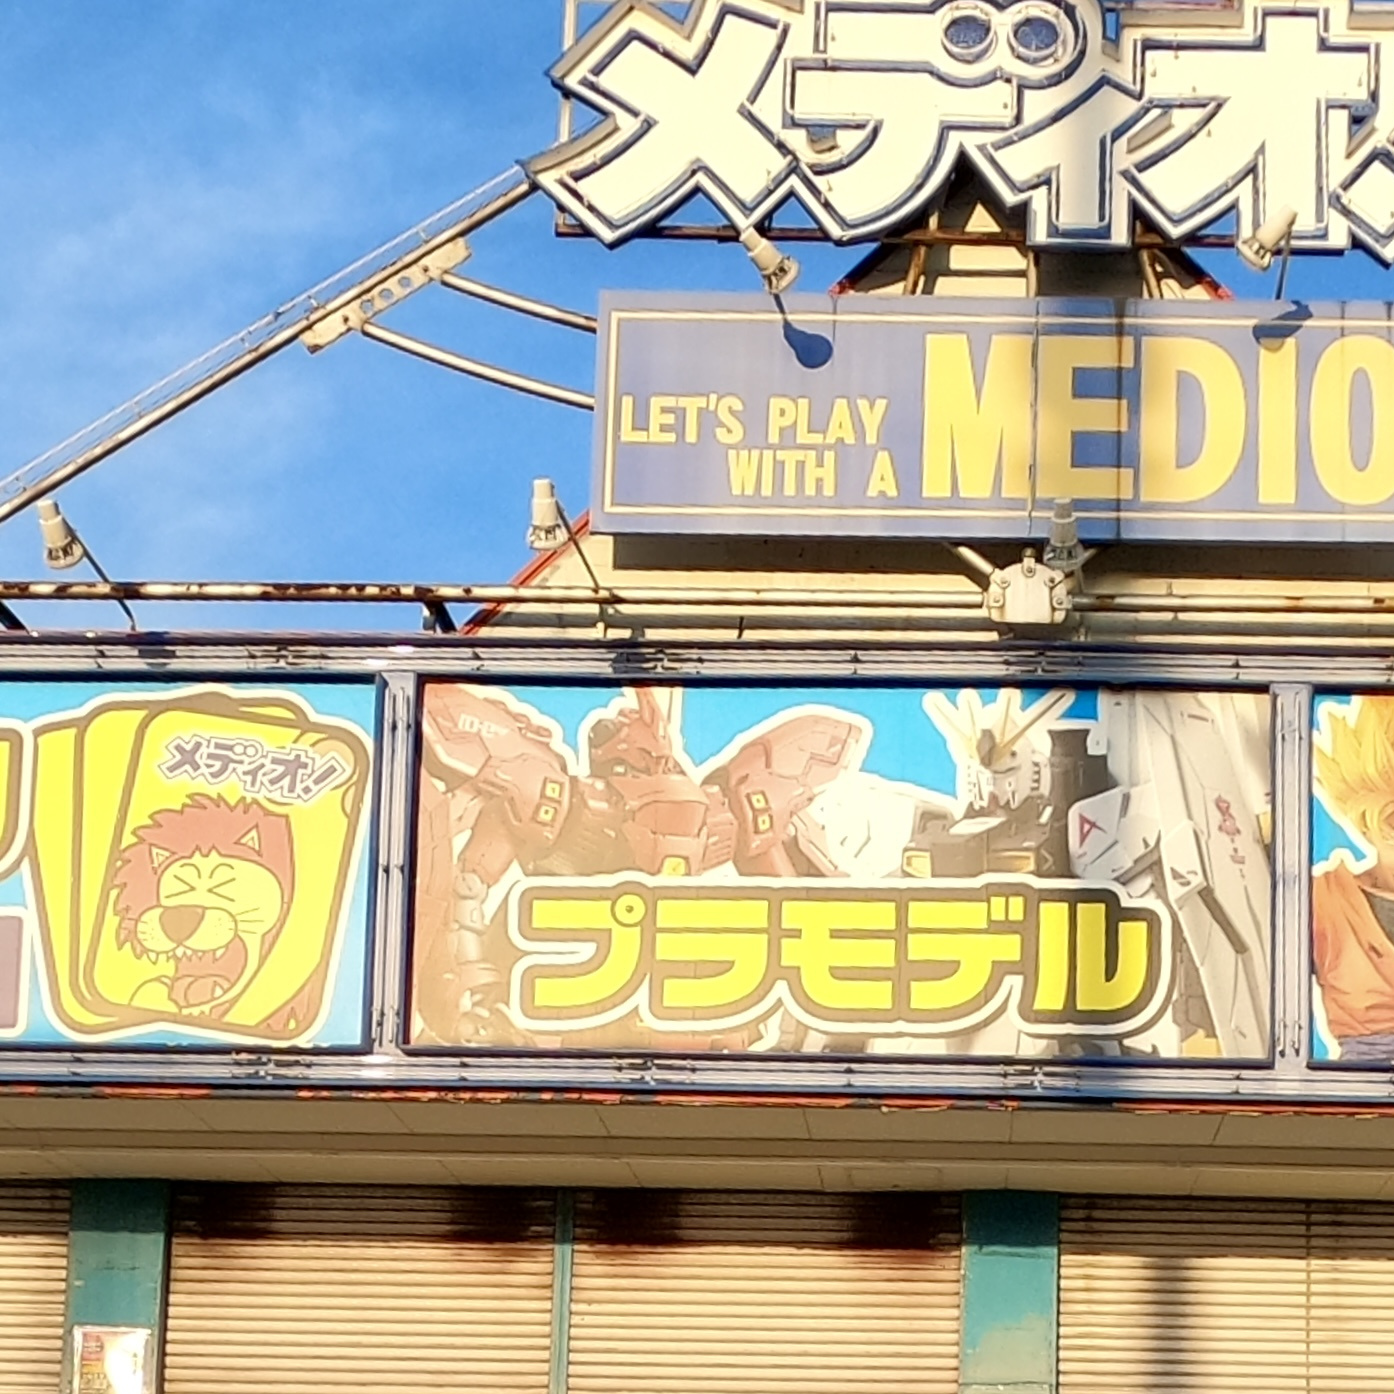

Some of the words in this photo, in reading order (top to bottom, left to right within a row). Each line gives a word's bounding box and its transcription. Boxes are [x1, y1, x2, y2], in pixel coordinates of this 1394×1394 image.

[619, 394, 743, 445] LET'S
[768, 396, 887, 446] PLAY
[727, 448, 836, 498] WITH
[867, 449, 898, 498] A
[526, 890, 1152, 1014] プラモデル
